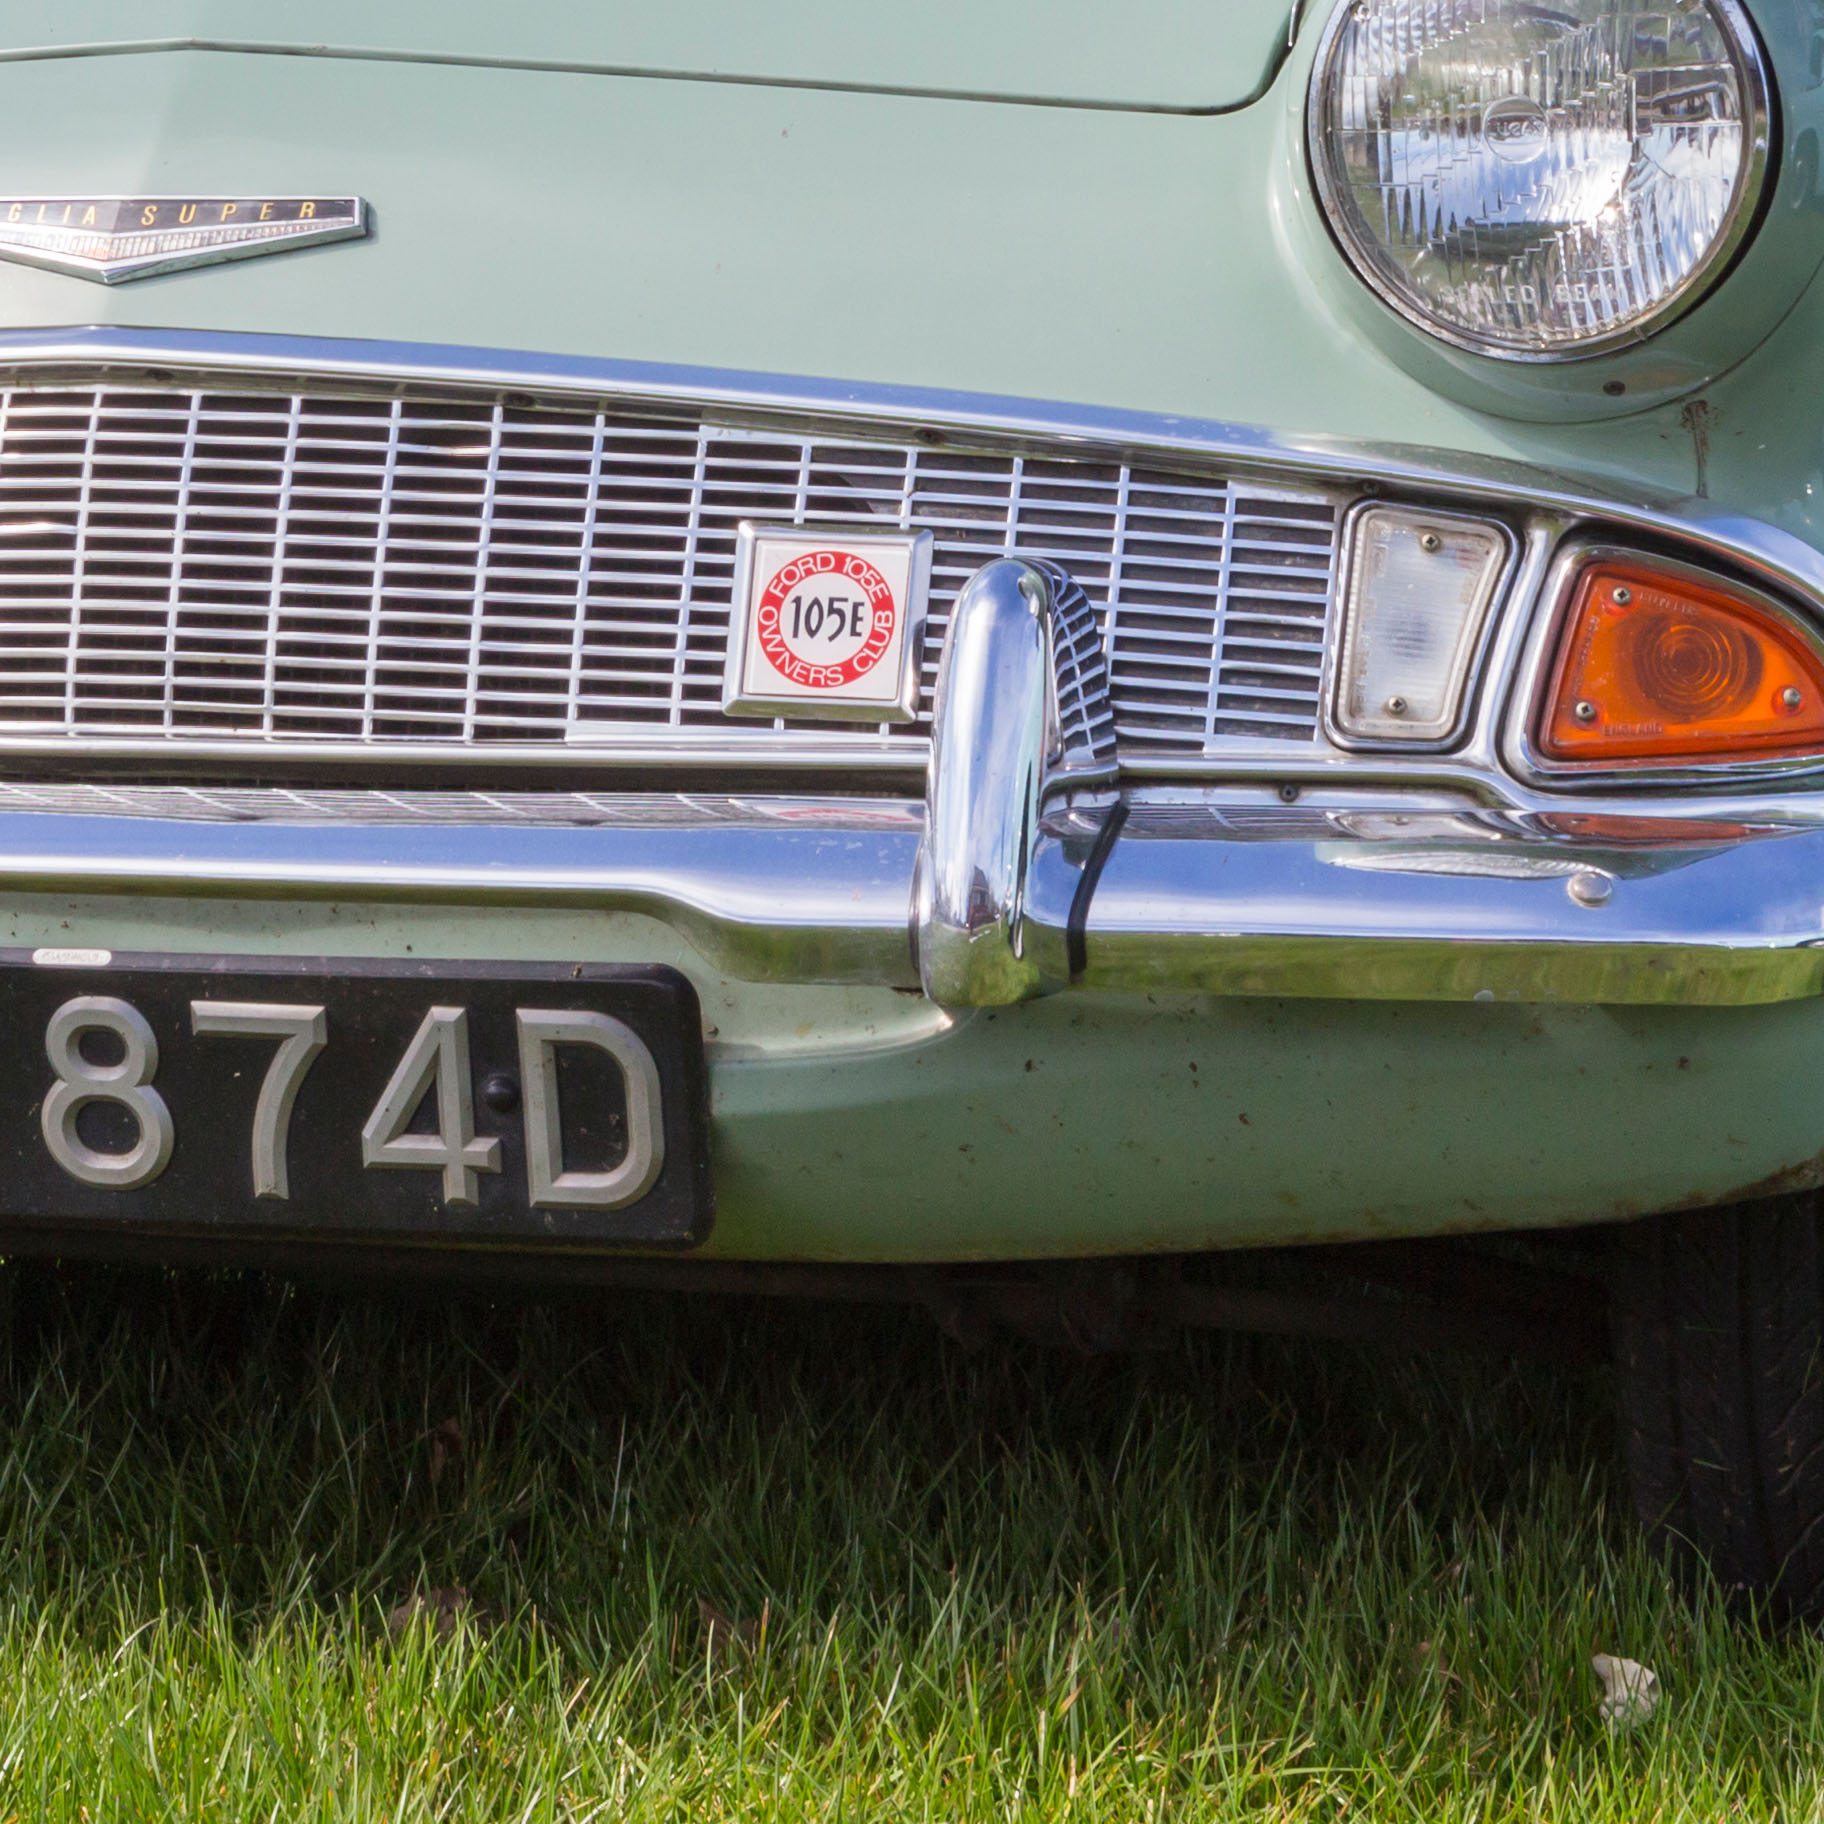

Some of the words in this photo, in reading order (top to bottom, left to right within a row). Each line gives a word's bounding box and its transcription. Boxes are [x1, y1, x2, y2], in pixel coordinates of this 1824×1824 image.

[140, 200, 317, 227] SUPER
[768, 553, 836, 599] FORD
[843, 556, 890, 604] 105E
[790, 595, 865, 643] 105E
[758, 606, 845, 687] OWNERS
[852, 610, 893, 673] CLUB
[40, 994, 666, 1211] 874D
